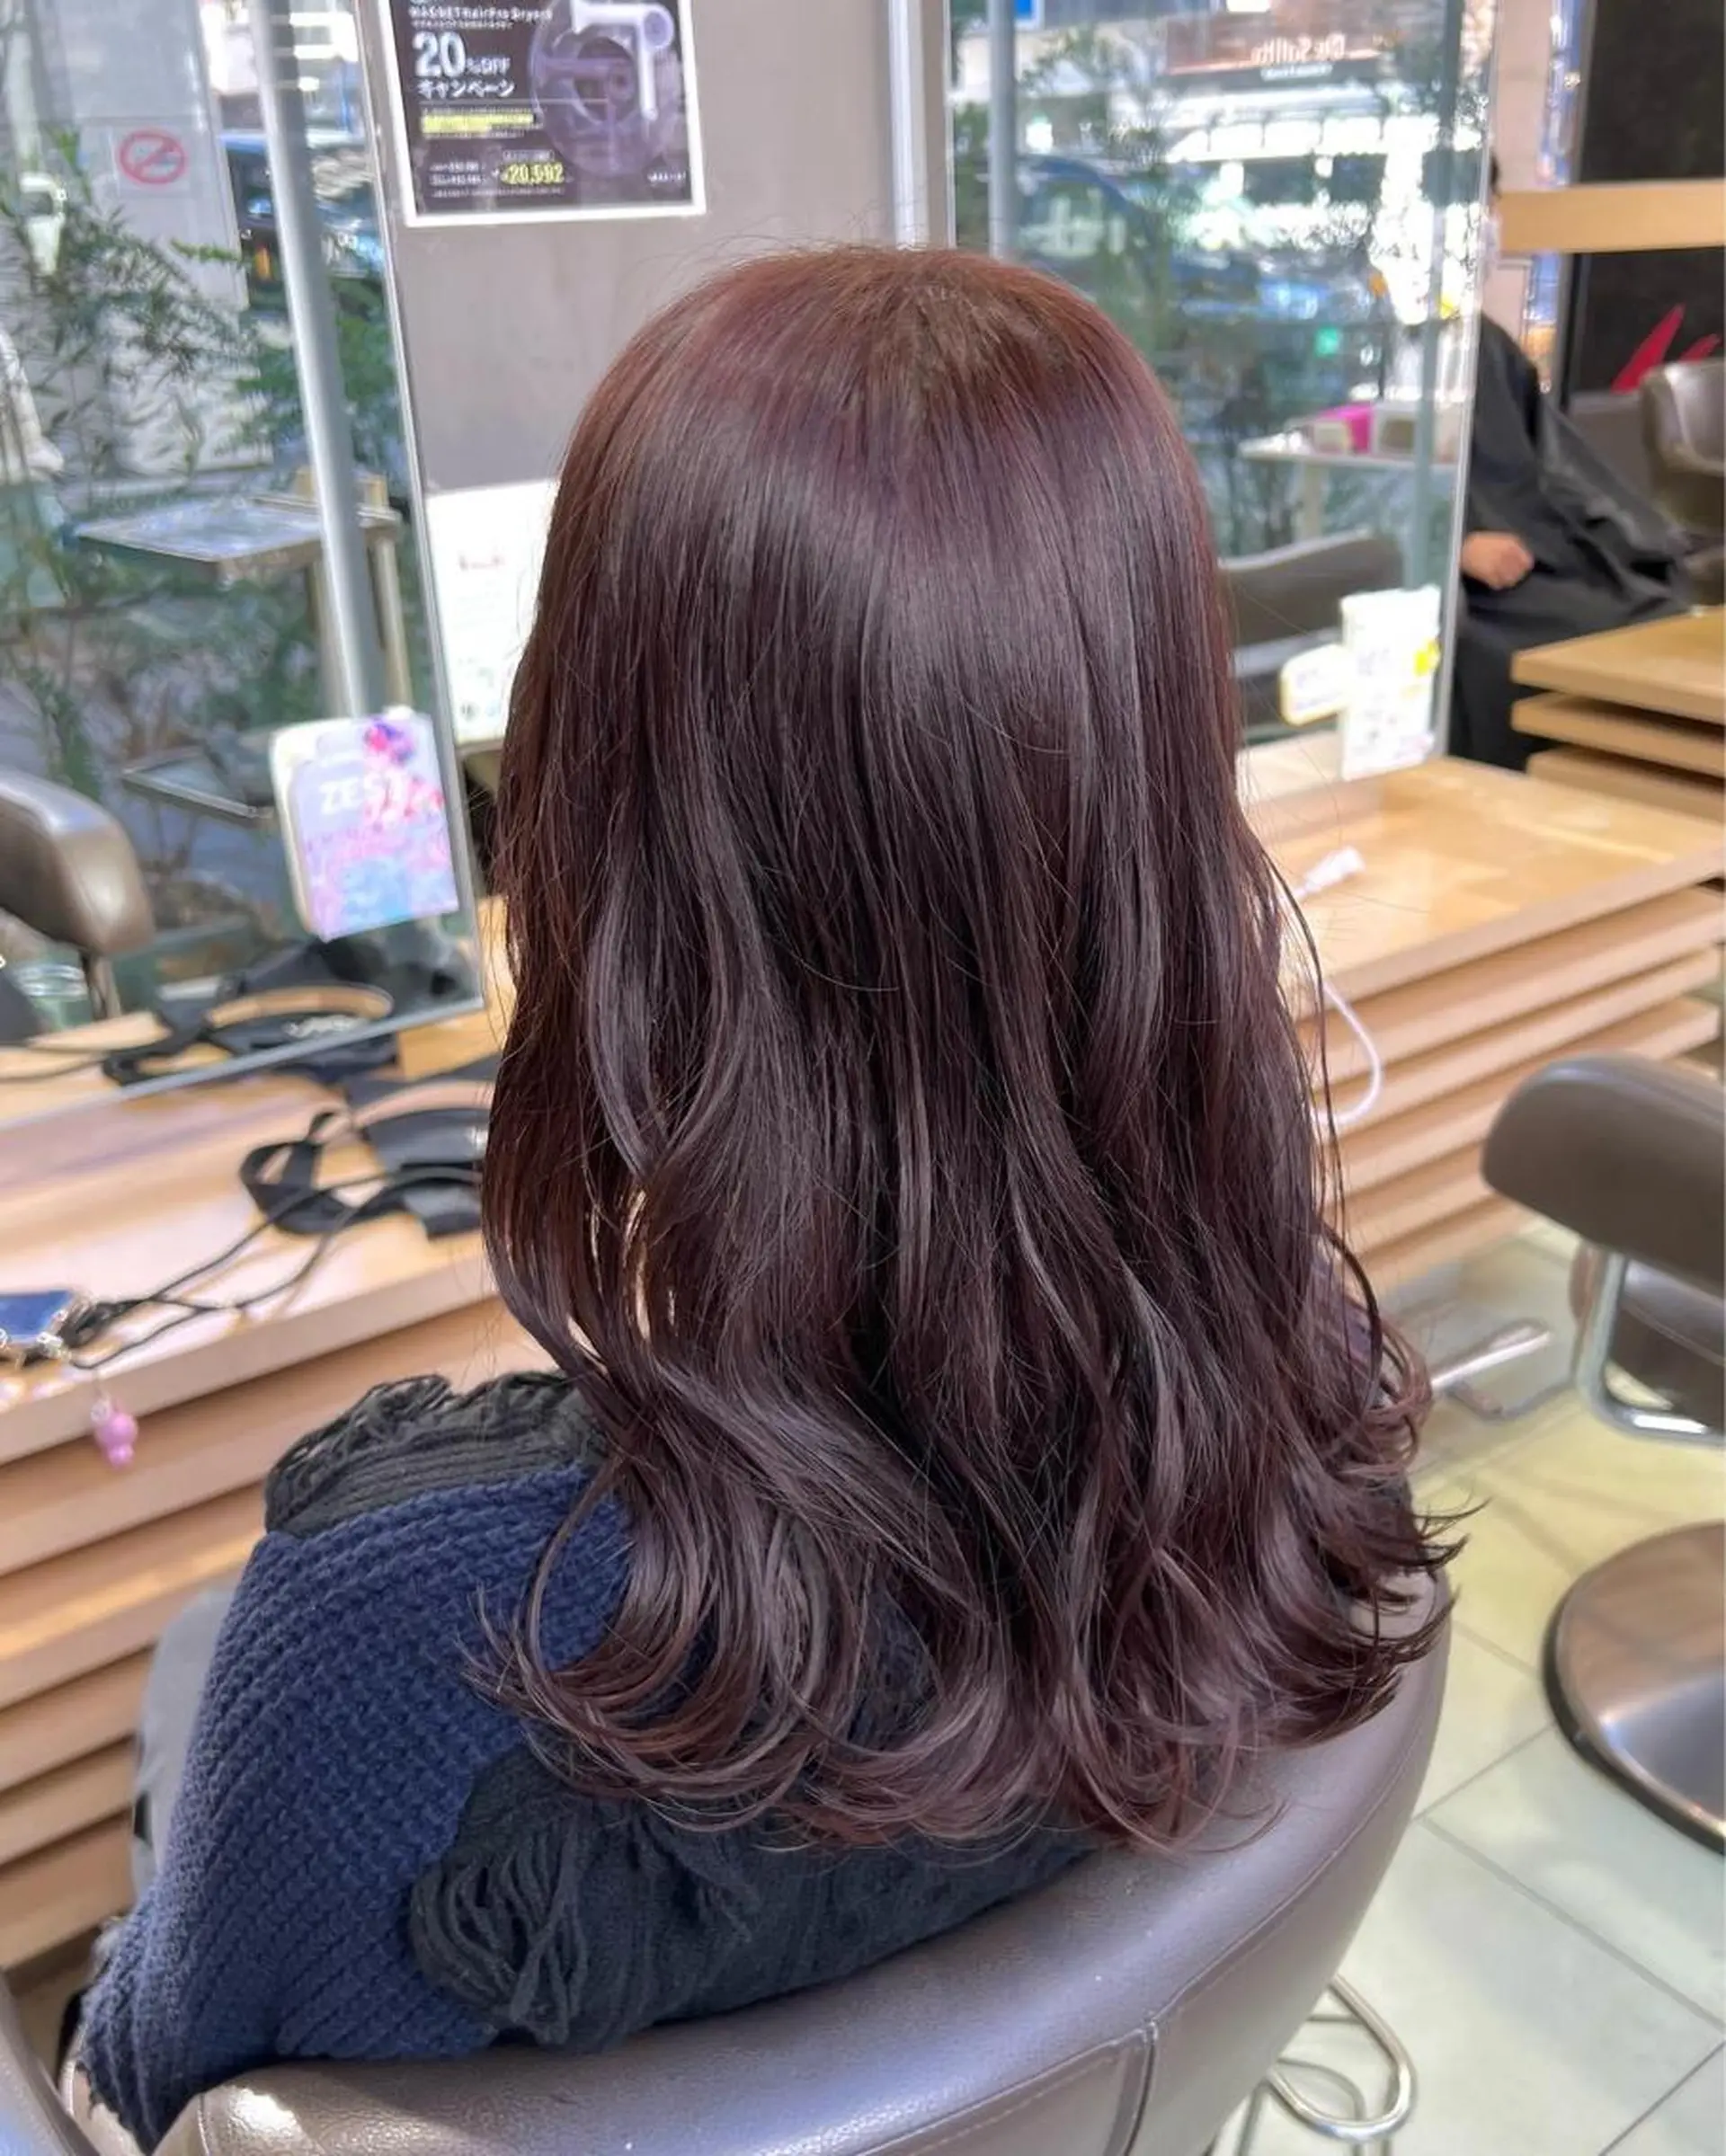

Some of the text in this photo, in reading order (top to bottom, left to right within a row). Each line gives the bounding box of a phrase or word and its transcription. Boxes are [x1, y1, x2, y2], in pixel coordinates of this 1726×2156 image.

[418, 79, 515, 100] キャンペーン
